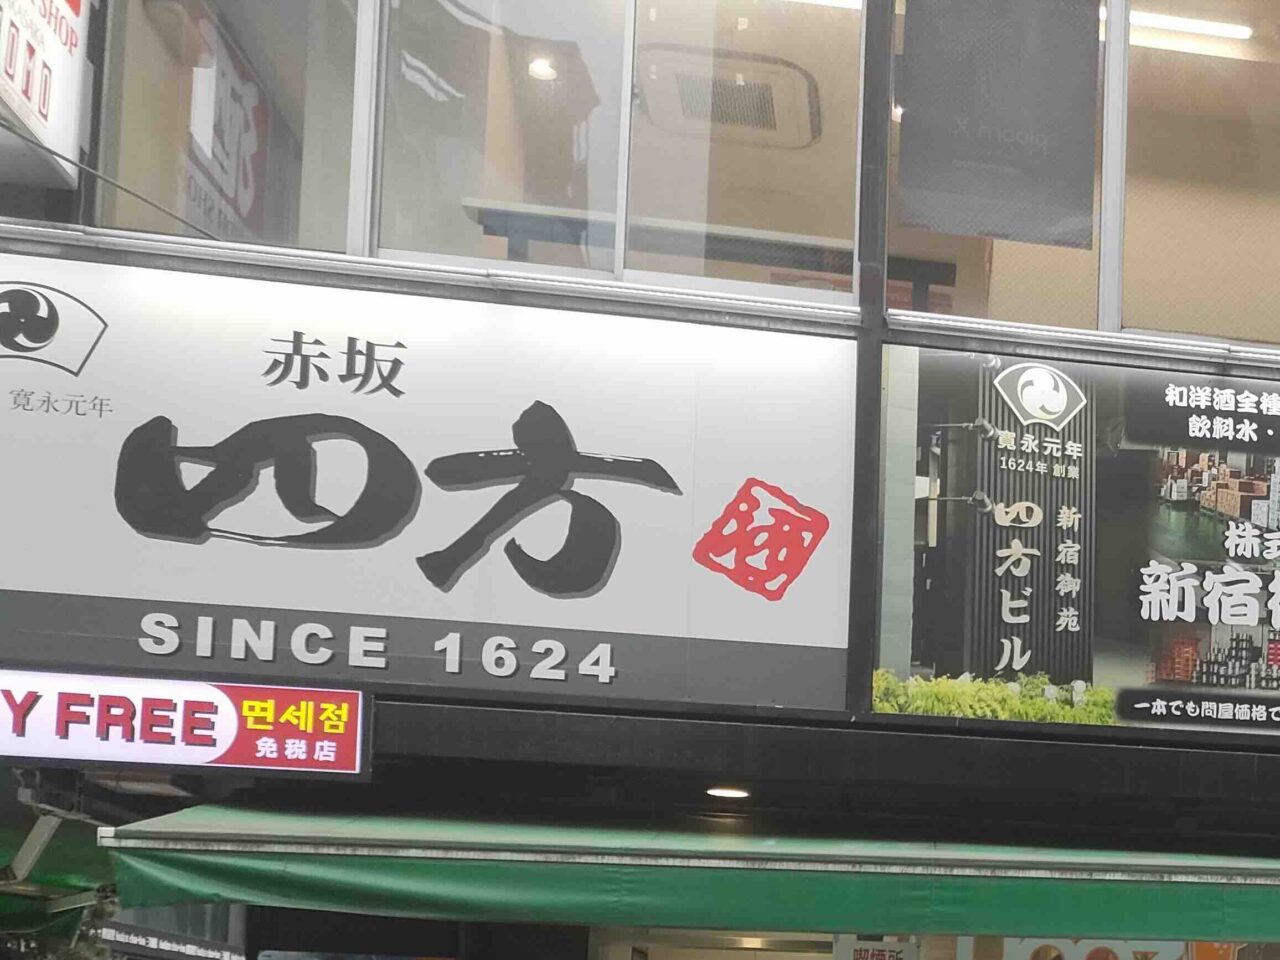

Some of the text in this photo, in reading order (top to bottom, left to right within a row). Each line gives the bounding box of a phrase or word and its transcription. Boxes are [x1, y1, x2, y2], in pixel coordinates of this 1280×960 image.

[261, 331, 408, 398] 赤坂
[9, 388, 114, 419] 寛永元年
[997, 430, 1083, 460] 寛永元年
[1000, 456, 1080, 479] 1624年 創業
[114, 400, 683, 599] 四方
[994, 501, 1044, 672] 四方ビル
[1055, 505, 1082, 633] 新宿御苑
[138, 612, 617, 683] SINCE 1624
[56, 691, 218, 748] FREE
[242, 699, 349, 735] 면세점
[255, 736, 337, 762] 免税店
